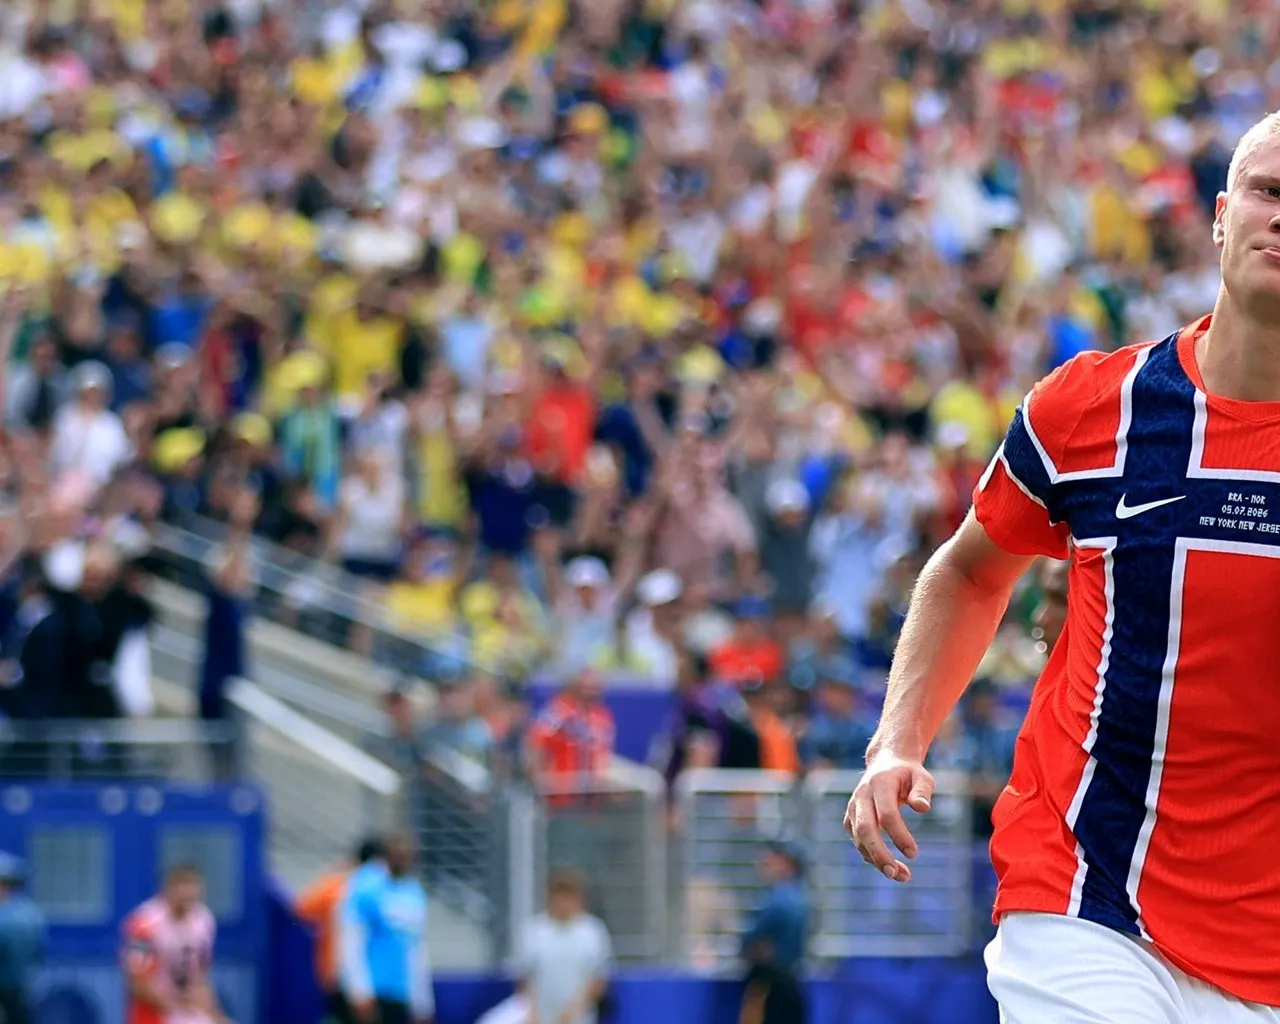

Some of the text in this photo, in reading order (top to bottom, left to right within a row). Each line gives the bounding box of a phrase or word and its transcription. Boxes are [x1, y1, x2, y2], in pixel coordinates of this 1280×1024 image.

[1228, 492, 1242, 502] BRA
[1250, 494, 1266, 504] NOR
[1221, 504, 1268, 518] 05.07.2026
[1199, 516, 1216, 526] NEW
[1217, 517, 1238, 529] YORK
[1238, 520, 1255, 530] NEW
